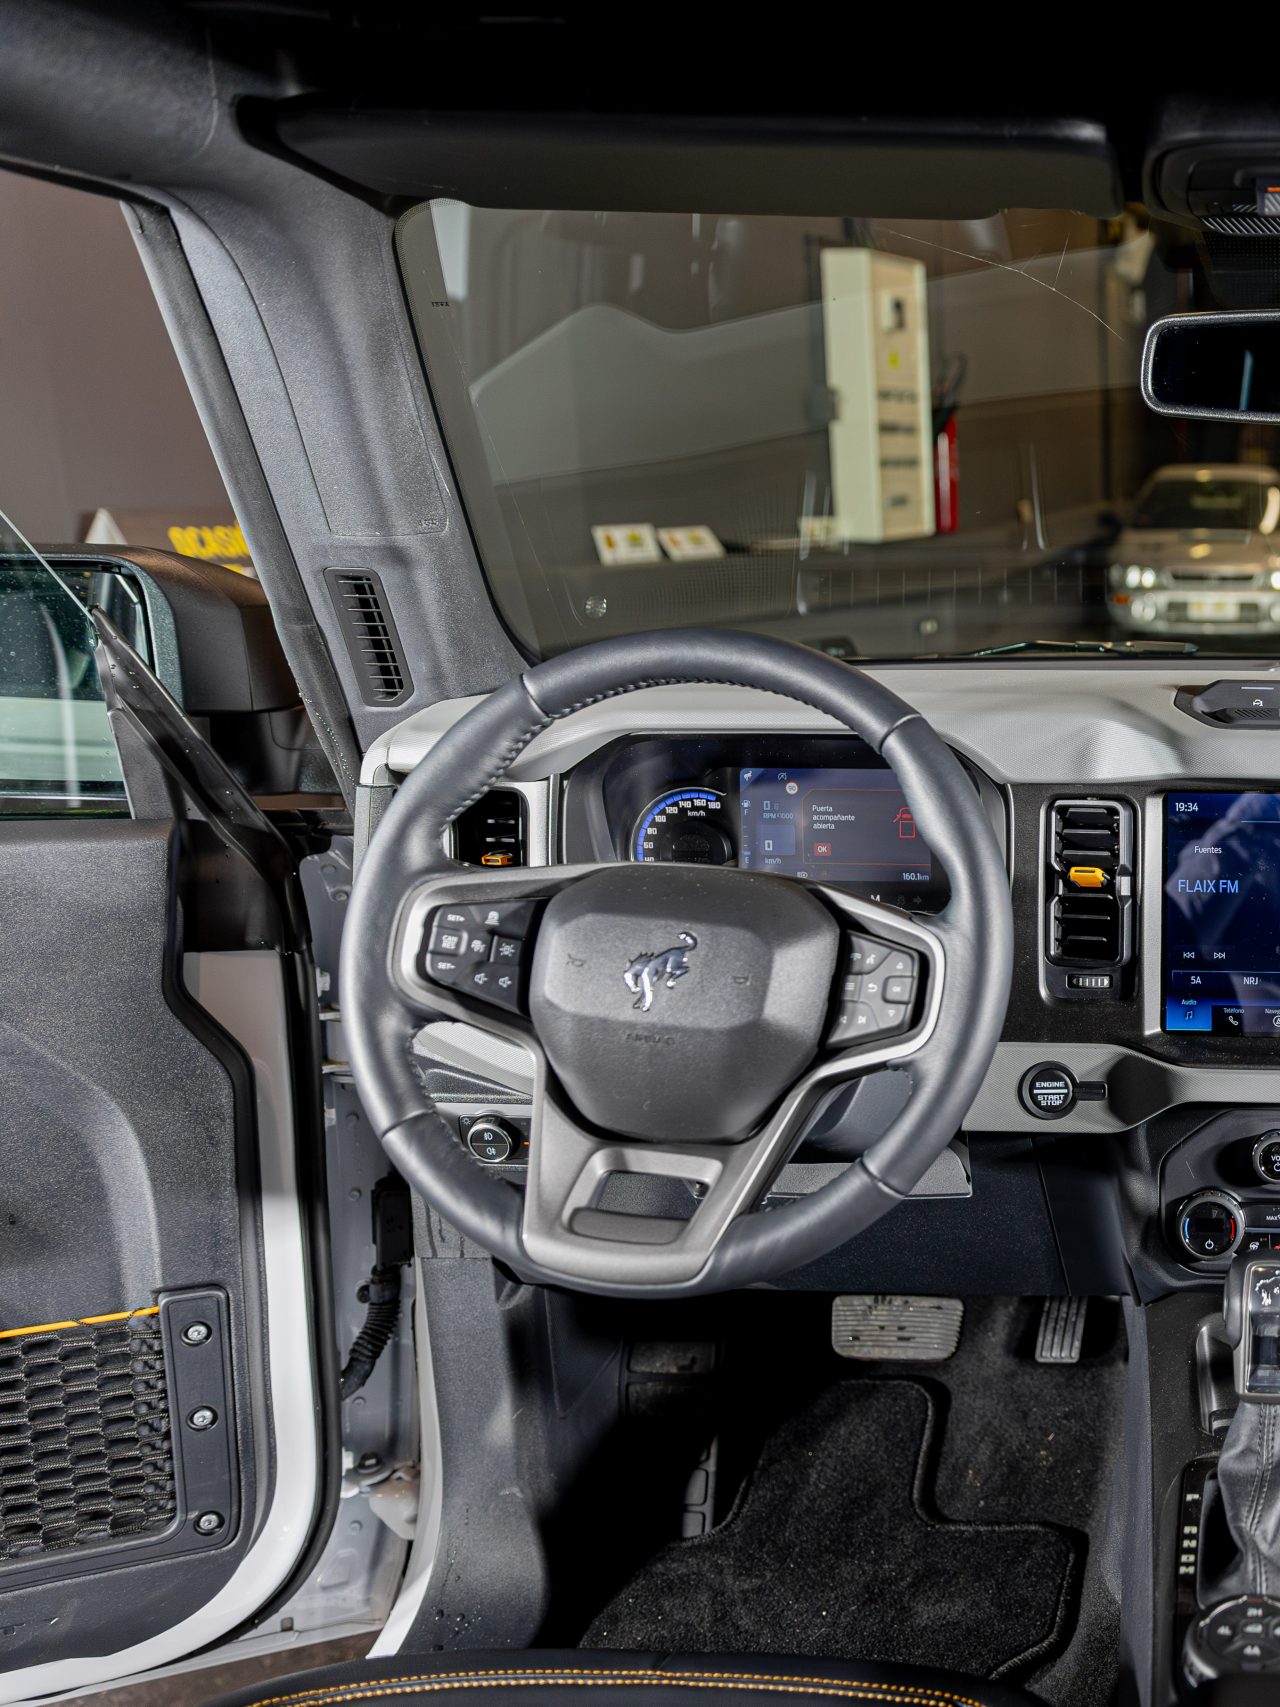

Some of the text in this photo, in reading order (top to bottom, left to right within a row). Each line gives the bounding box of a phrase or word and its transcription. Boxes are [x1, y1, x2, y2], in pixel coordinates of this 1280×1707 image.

[678, 800, 692, 808] 140
[692, 799, 707, 807] 160
[707, 801, 721, 809] 180
[1175, 802, 1199, 812] 19:34
[665, 806, 678, 814] 120
[812, 804, 833, 812] Puerta
[654, 815, 666, 823] 100
[812, 822, 835, 830] abierta
[646, 827, 657, 835] 80
[643, 841, 654, 849] 60
[764, 840, 773, 851] 0
[1194, 846, 1222, 854] Fuentes
[764, 857, 782, 865] km/h
[1178, 879, 1239, 893] FLAIX FM
[1190, 975, 1202, 985] 5A
[1243, 976, 1259, 985] NRJ
[1181, 998, 1197, 1006] Audio
[1182, 1539, 1197, 1548] N
[1180, 1554, 1196, 1563] D
[1179, 1565, 1196, 1575] M
